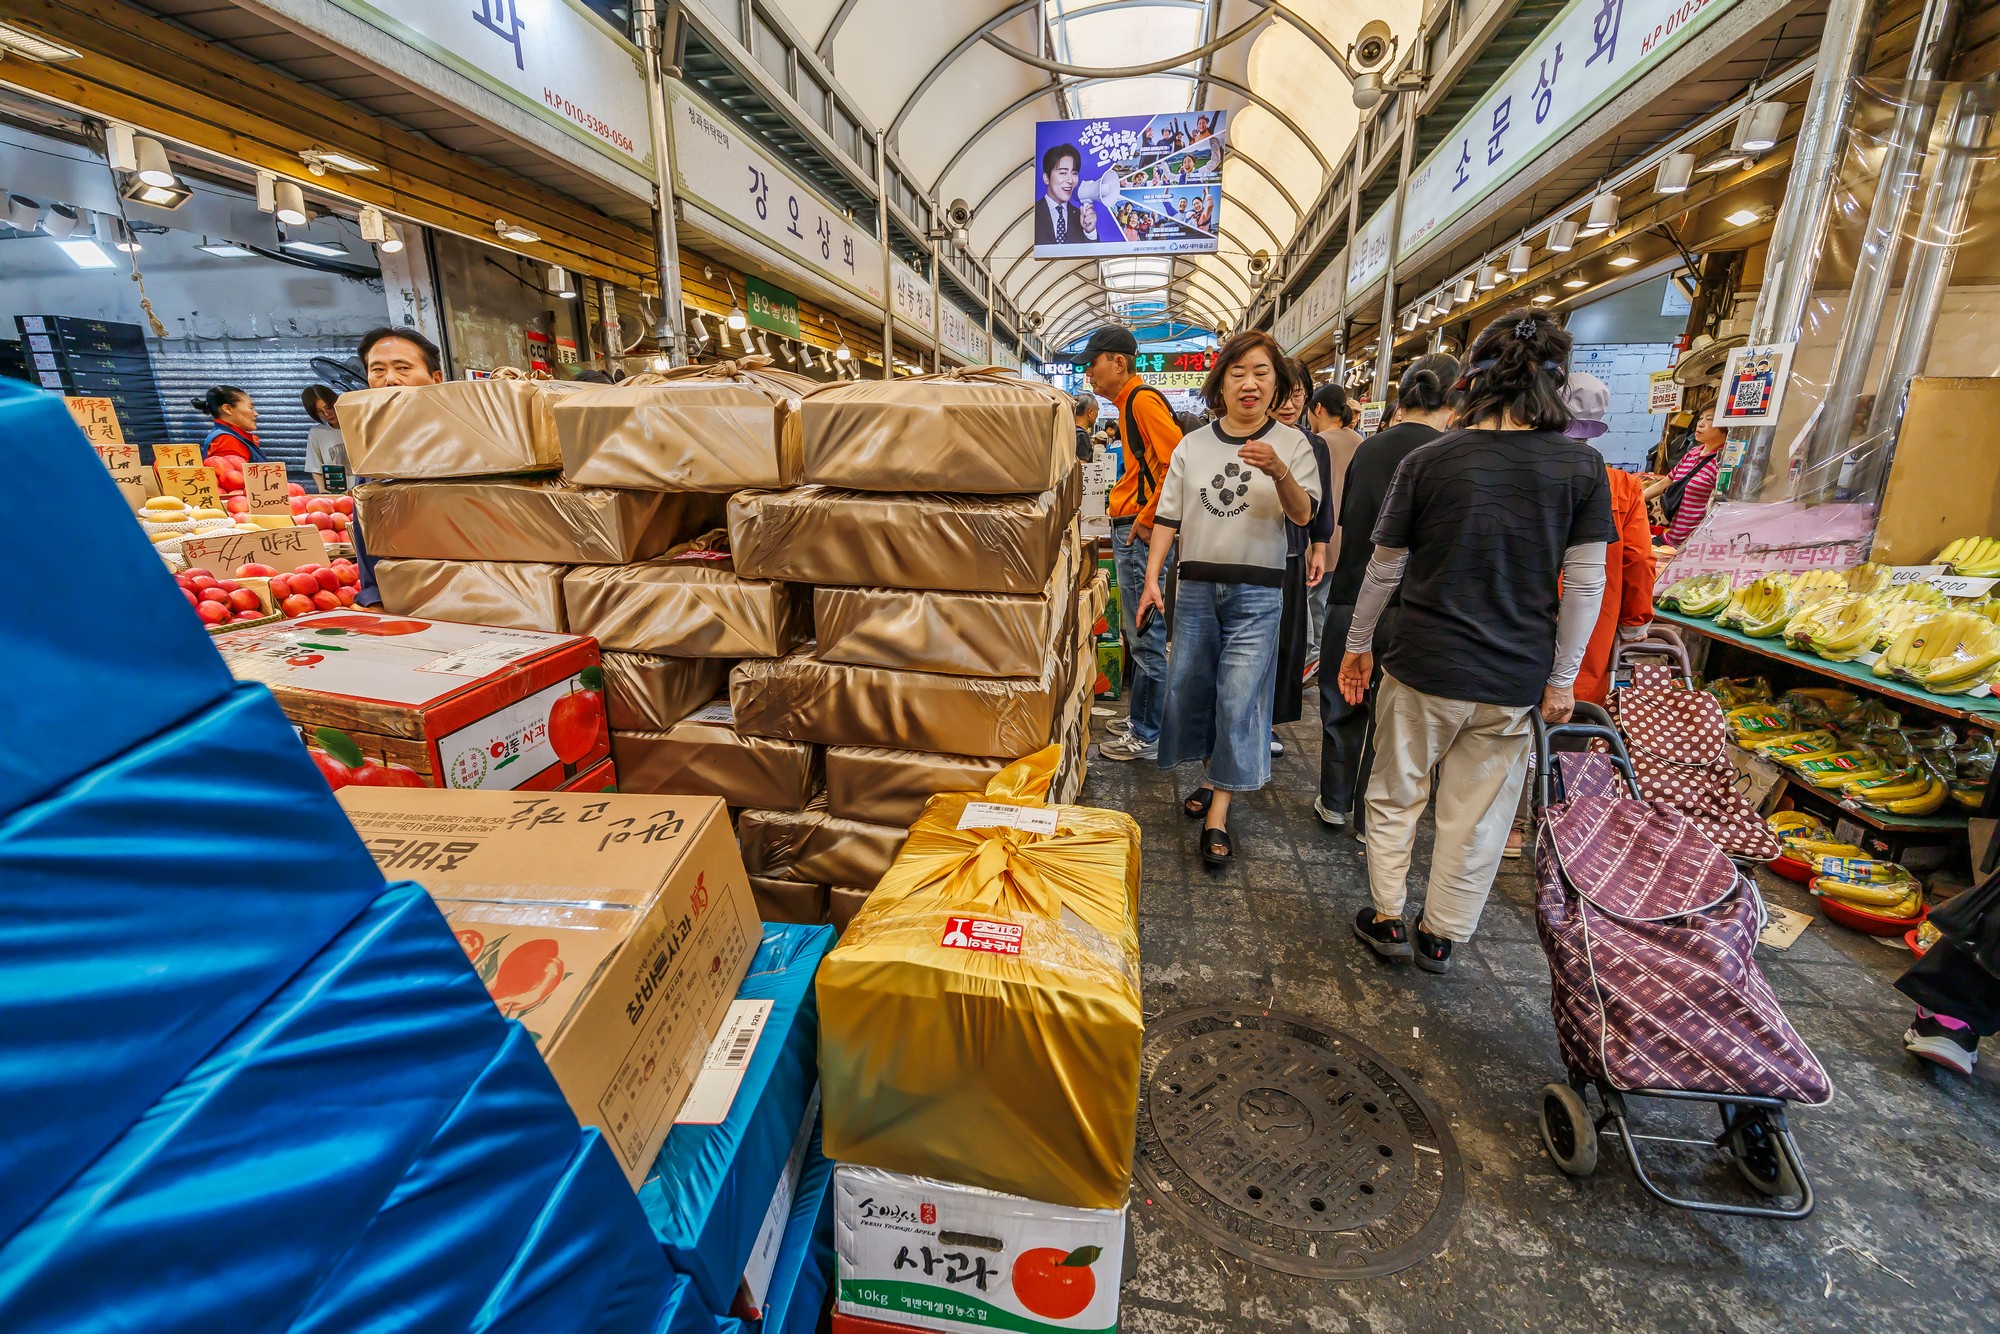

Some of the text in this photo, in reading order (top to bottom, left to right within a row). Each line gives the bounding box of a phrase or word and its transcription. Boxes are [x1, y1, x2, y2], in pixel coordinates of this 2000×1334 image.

[1641, 33, 1662, 56] H.P
[1452, 0, 1623, 193] 소문상회
[543, 87, 634, 153] H.P 010-5389-0564
[688, 106, 731, 150] 청과위탁판매
[748, 165, 855, 275] 강오상회
[1189, 242, 1213, 250] 새마을금고
[751, 291, 797, 325] 강오 상회
[896, 275, 932, 326] 삼동청과
[1591, 352, 1598, 360] 9
[1652, 393, 1677, 405] 참여점포
[1226, 501, 1250, 518] FIORE
[488, 737, 520, 759] 영동
[522, 723, 546, 745] 사과
[968, 936, 1020, 954] 파손주의
[625, 913, 693, 1026] 참바른사과
[860, 1219, 937, 1237] FRESH YEONGJU APPLE
[893, 1245, 999, 1292] 사과
[857, 1287, 988, 1321] 10kg 에벤에셀영농조합
